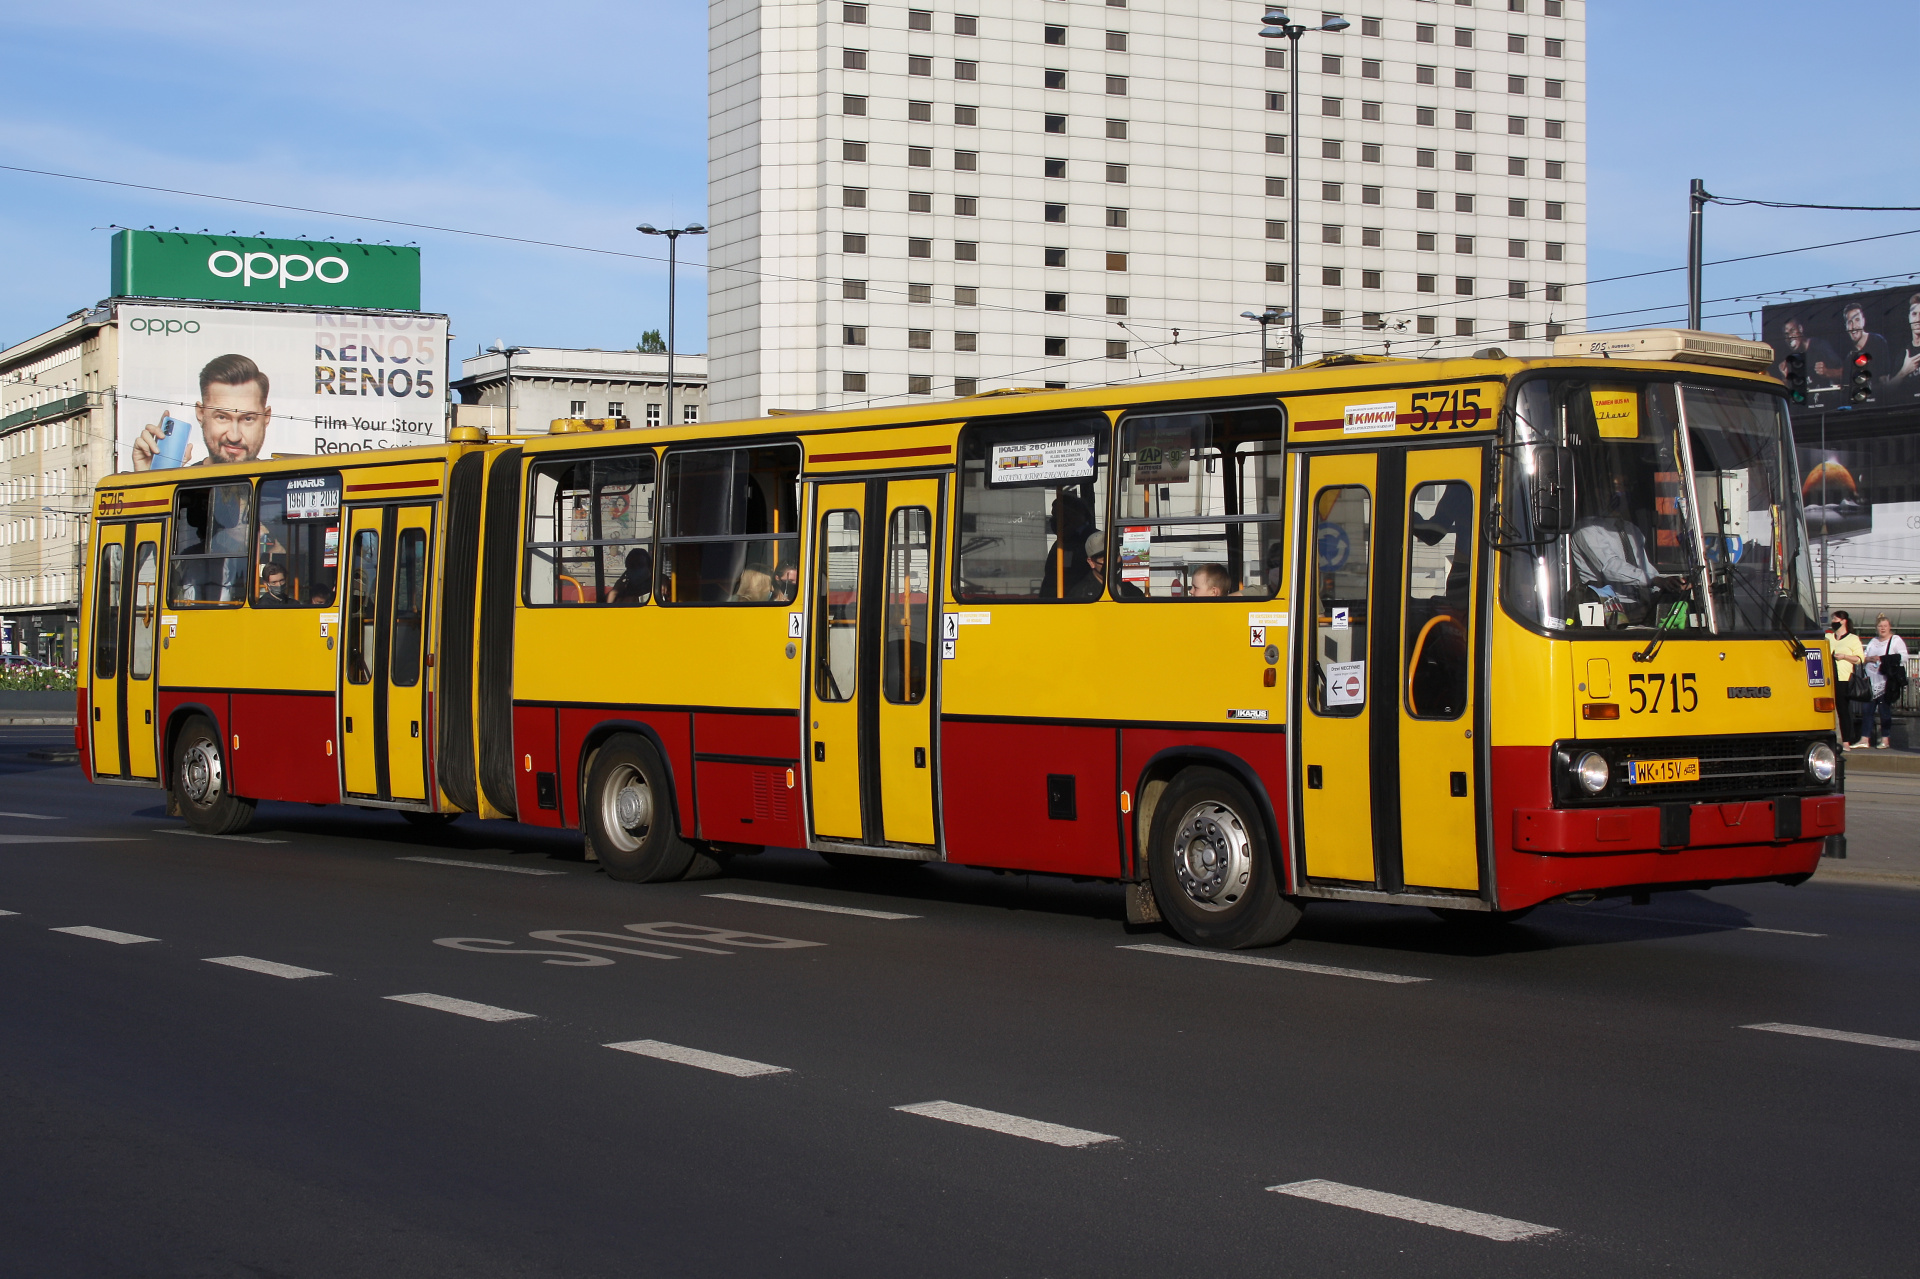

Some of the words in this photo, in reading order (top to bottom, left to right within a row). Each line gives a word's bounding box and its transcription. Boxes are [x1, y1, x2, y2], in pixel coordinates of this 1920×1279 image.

[207, 250, 349, 289] oppo
[130, 318, 200, 336] oppo
[315, 332, 435, 365] RENO5
[315, 366, 434, 398] RENO5
[1355, 411, 1395, 425] KMKM
[1410, 388, 1481, 432] 5715
[315, 416, 347, 430] Film
[352, 417, 387, 431] Your
[392, 418, 433, 436] Story
[293, 478, 325, 489] IKARUS
[100, 492, 125, 515] 5715
[320, 490, 338, 507] 2013
[1587, 605, 1595, 625] 7
[1629, 673, 1698, 714] 5715
[1727, 686, 1771, 698] IKARUS
[1237, 709, 1267, 717] IKARUS
[1637, 763, 1655, 781] WK
[1661, 761, 1681, 780] 15V
[432, 921, 829, 967] BUS
